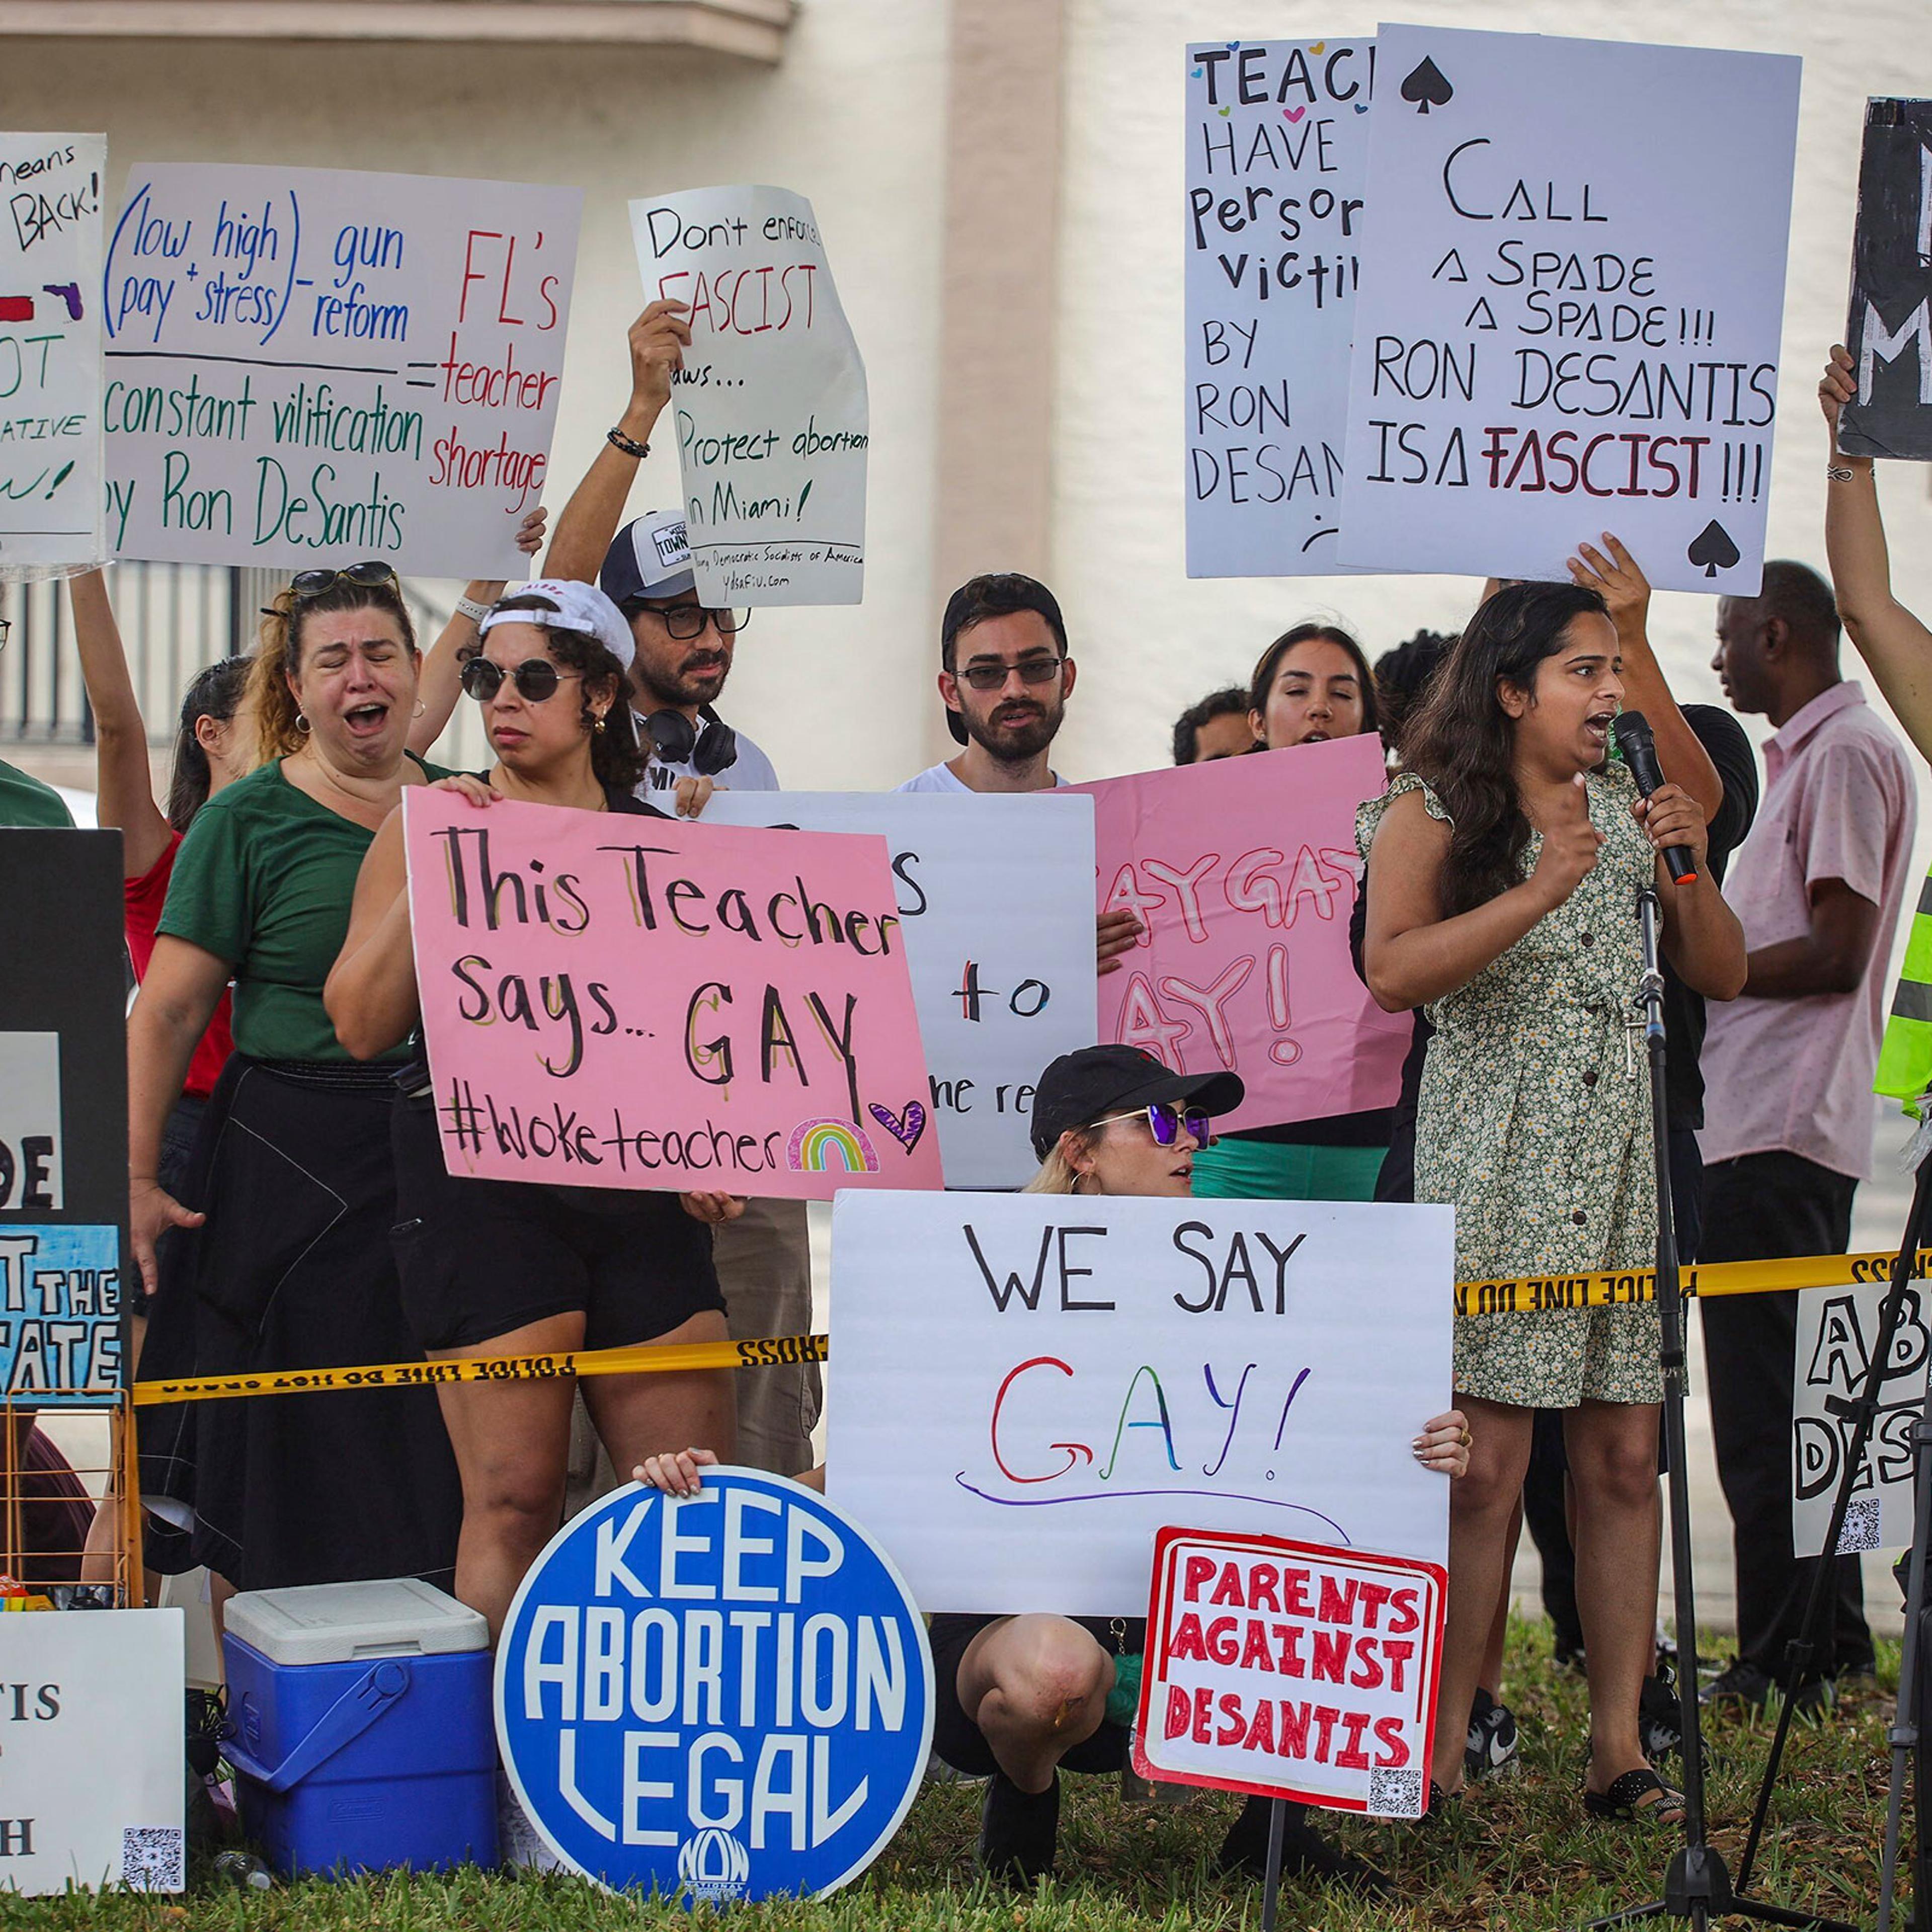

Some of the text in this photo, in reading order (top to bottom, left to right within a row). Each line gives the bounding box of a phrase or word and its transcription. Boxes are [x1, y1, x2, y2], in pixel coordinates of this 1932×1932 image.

[1202, 119, 1338, 175] HAVE
[1443, 138, 1608, 221] CALL
[10, 172, 99, 252] BACK!
[133, 197, 191, 257] low
[212, 201, 277, 280] high
[647, 208, 748, 259] Don't
[334, 226, 403, 288] gun
[459, 230, 559, 331] FL's
[1432, 240, 1656, 297] A SPADE
[117, 277, 175, 342] pay
[196, 272, 277, 325] stress
[313, 282, 408, 342] reform
[1202, 319, 1258, 369] BY
[1465, 297, 1498, 329] A
[440, 331, 558, 411] teacher
[1196, 379, 1290, 434] RON
[1373, 336, 1776, 426] RON DESANTIS
[105, 374, 424, 461] constant vilification
[677, 410, 869, 472] Protect abortion
[163, 451, 232, 535] Ron
[253, 455, 405, 551] DeSantis
[429, 426, 547, 514] shortage
[712, 478, 814, 526] Miami!
[430, 826, 900, 955] This Teacher
[950, 960, 1051, 1022] to
[684, 983, 862, 1127] GAY
[33, 1268, 119, 1317] THE
[963, 1221, 1307, 1314] WE SAY
[472, 1355, 577, 1381] POLICE
[991, 1356, 1311, 1484] GAY!
[595, 1487, 845, 1604] KEEP
[1184, 1556, 1420, 1634] PARENTS
[524, 1604, 907, 1732] ABORTION
[1168, 1612, 1415, 1693] AGAINST
[1164, 1684, 1411, 1771] DESANTIS
[558, 1728, 869, 1852] LEGAL
[677, 1828, 750, 1883] NOW
